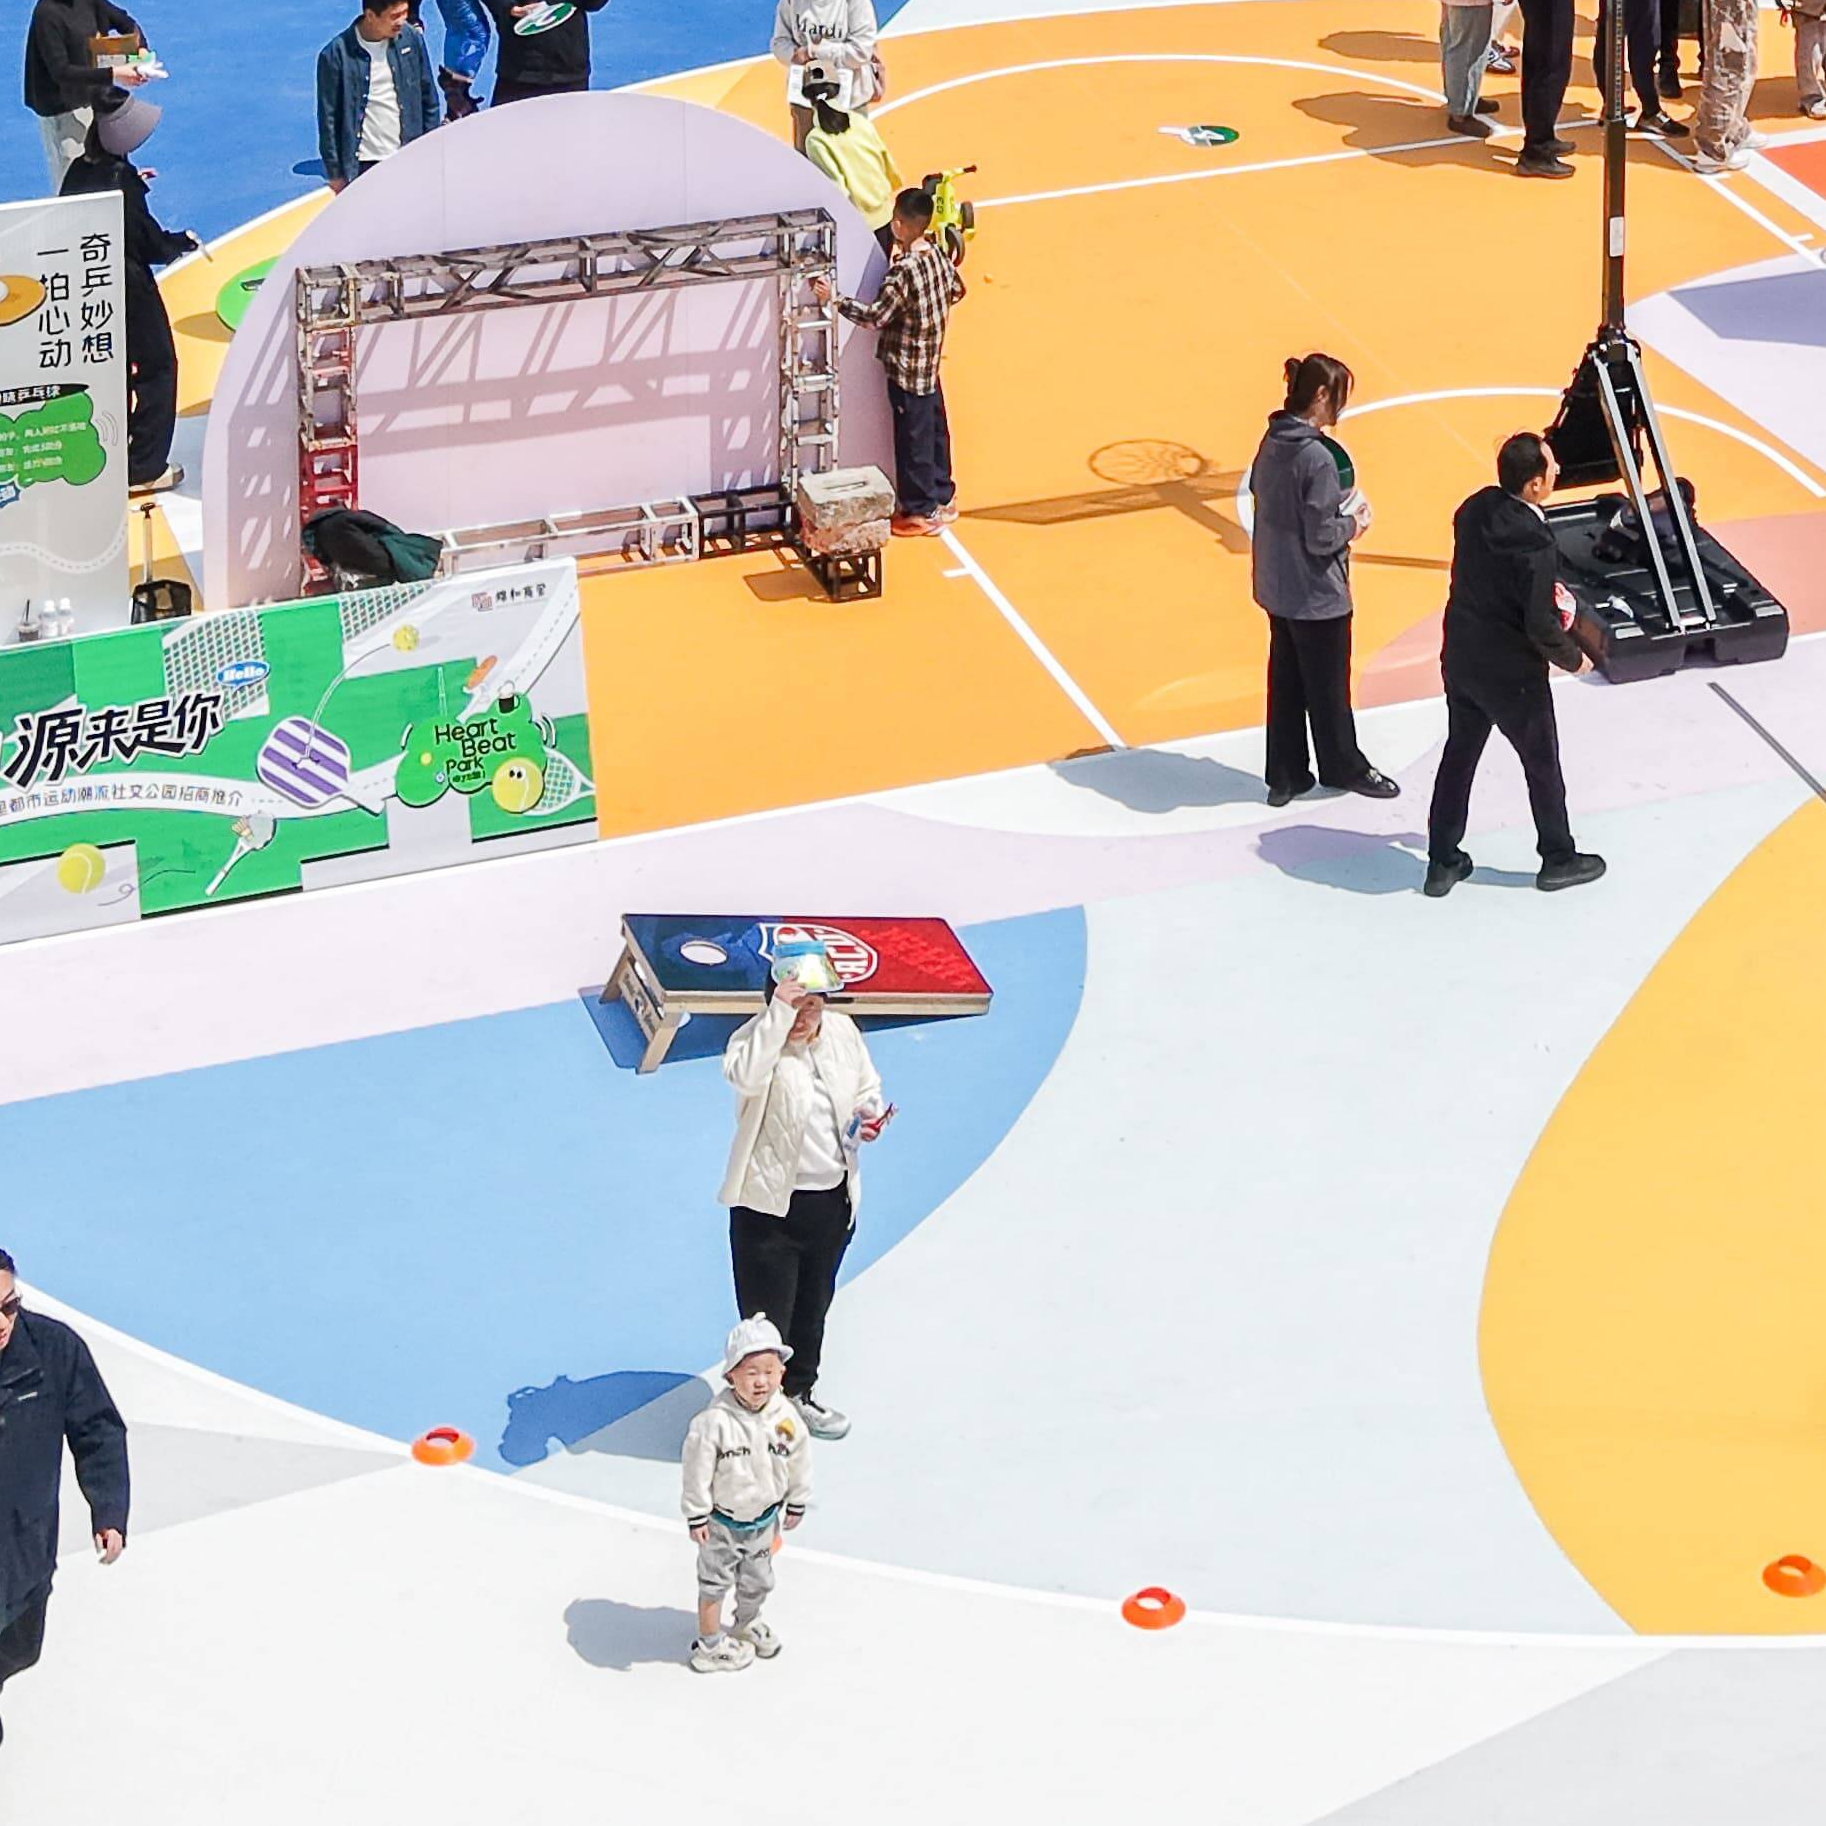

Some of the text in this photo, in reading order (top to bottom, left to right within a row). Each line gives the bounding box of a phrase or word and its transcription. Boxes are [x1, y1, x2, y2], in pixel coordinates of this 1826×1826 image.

[37, 248, 72, 370] 一拍心动
[79, 232, 115, 365] 奇乒妙想
[221, 664, 267, 681] Hello
[435, 718, 498, 745] Heart
[462, 732, 517, 758] Beat
[446, 756, 484, 775] Park
